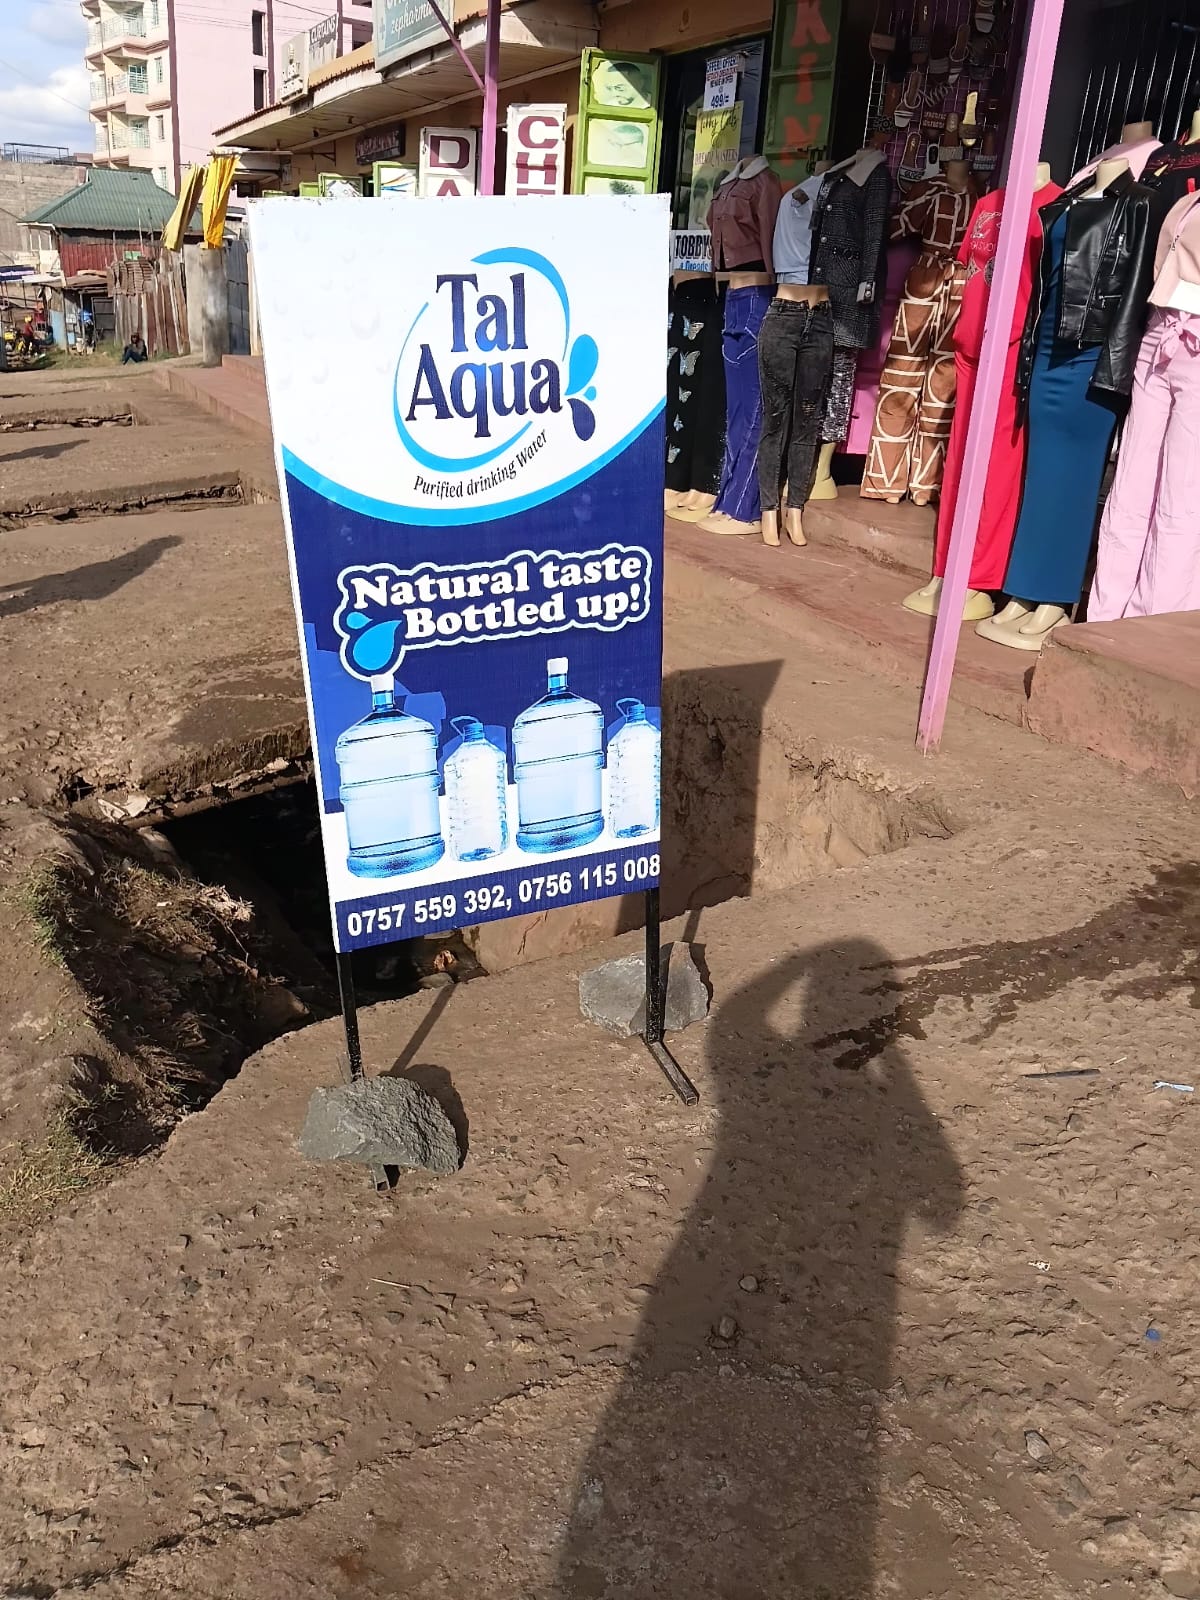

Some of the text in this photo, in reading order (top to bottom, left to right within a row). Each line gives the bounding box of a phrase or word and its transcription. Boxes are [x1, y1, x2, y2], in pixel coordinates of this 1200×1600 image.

[311, 15, 336, 44] CURTAINS
[516, 116, 559, 195] CH
[436, 273, 528, 352] Tal
[405, 344, 563, 438] Aqua
[413, 429, 548, 500] Purified drinking Water
[350, 553, 642, 609] Natural taste
[402, 583, 641, 639] Bottled up!
[347, 854, 660, 936] 0757 559 392, 0756 115 008
